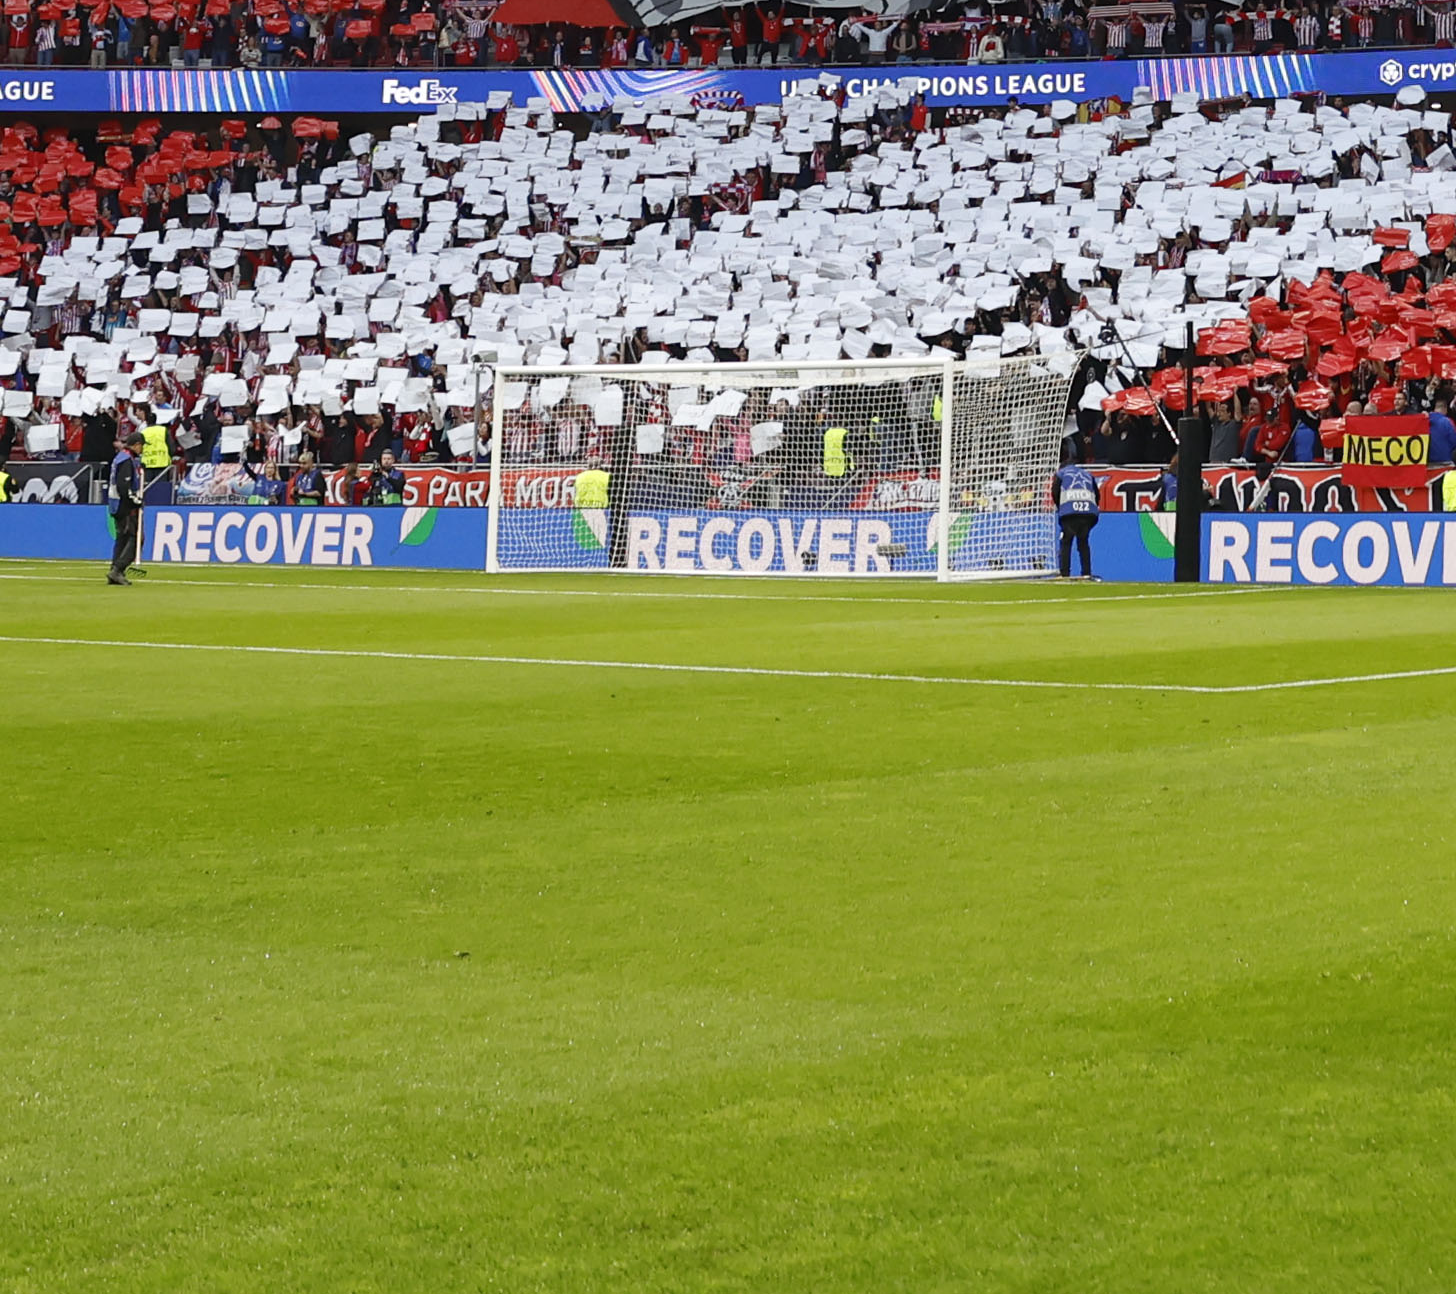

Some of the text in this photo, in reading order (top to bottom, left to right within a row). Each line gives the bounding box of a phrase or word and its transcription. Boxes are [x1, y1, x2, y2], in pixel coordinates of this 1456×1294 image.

[382, 79, 458, 105] FedEx
[994, 73, 1086, 95] LEAGUE
[1347, 435, 1423, 466] MECO
[1072, 501, 1090, 511] 022
[151, 511, 374, 566] RECOVER
[627, 515, 892, 572] RECOVER
